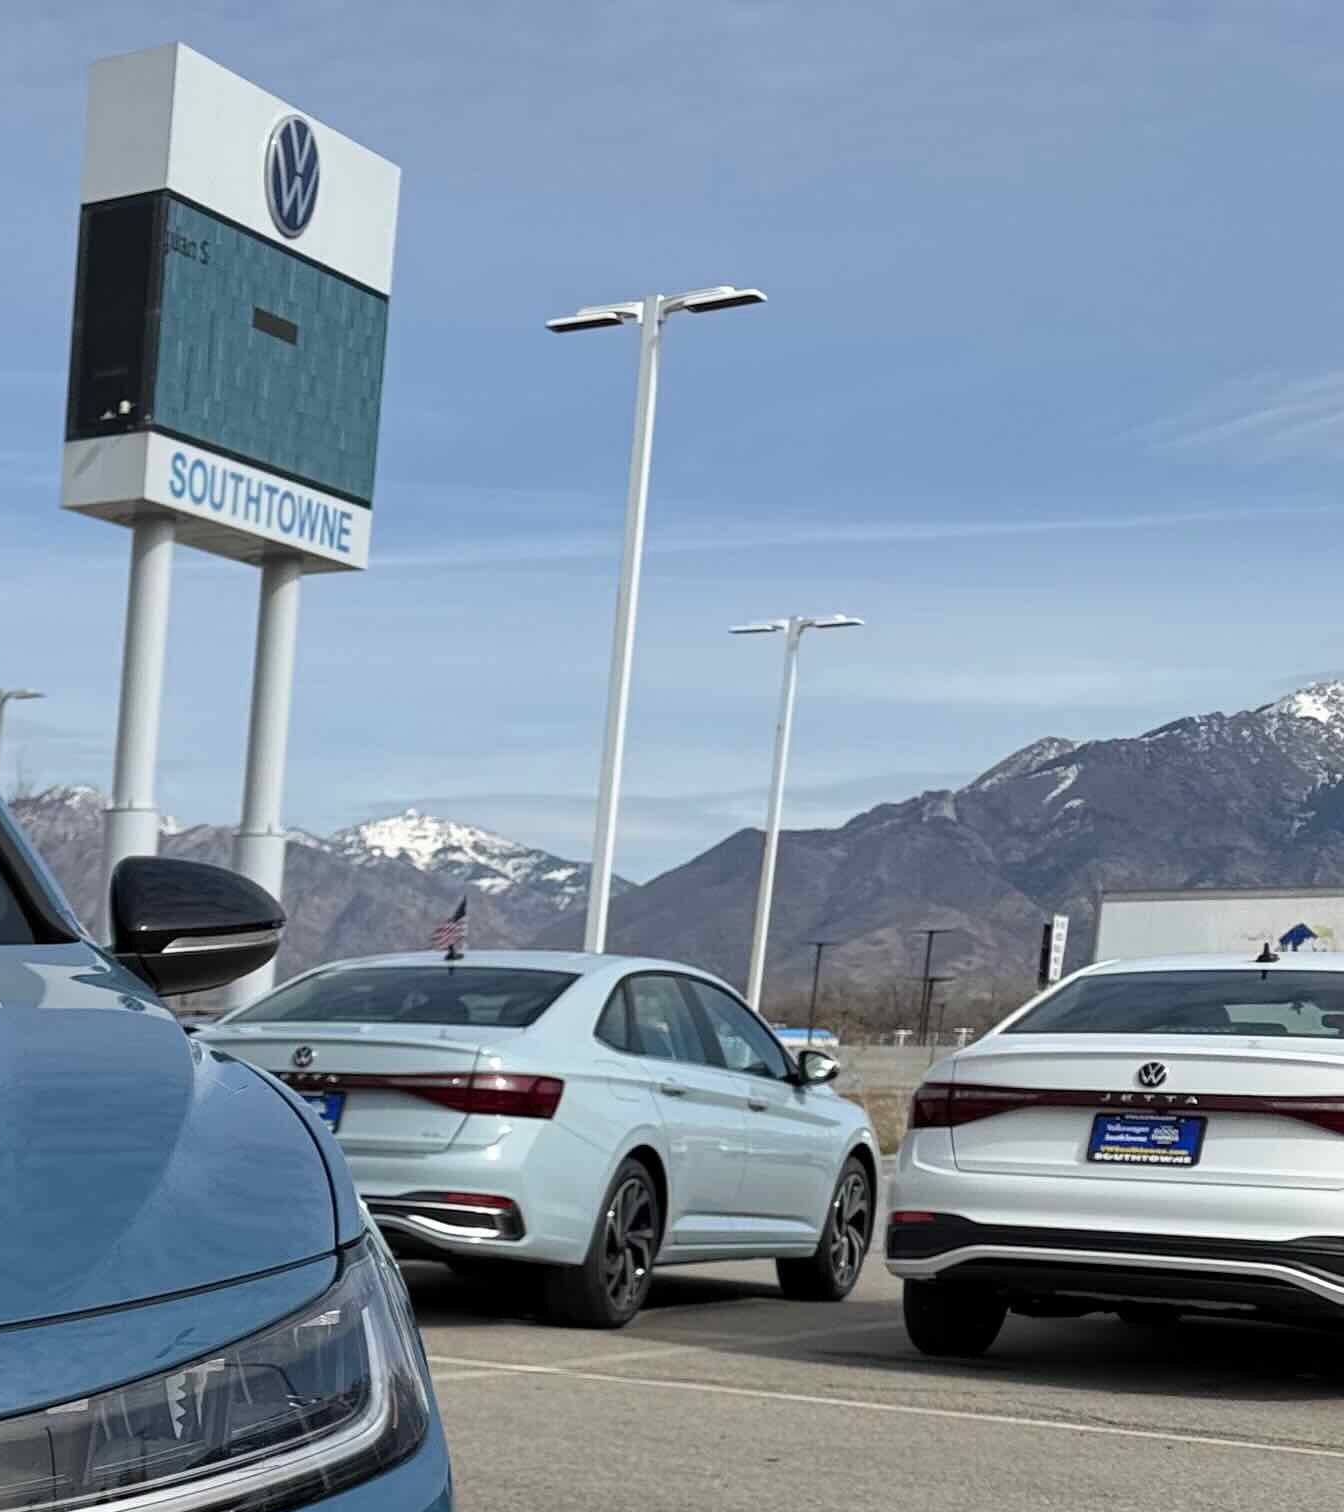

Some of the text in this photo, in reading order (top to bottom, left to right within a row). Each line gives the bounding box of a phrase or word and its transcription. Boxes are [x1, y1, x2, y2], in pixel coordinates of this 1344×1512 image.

[170, 452, 353, 553] SOUTHTOWNE
[1100, 1093, 1198, 1104] JETTA
[1094, 1152, 1192, 1163] SOUTHTOWNE
